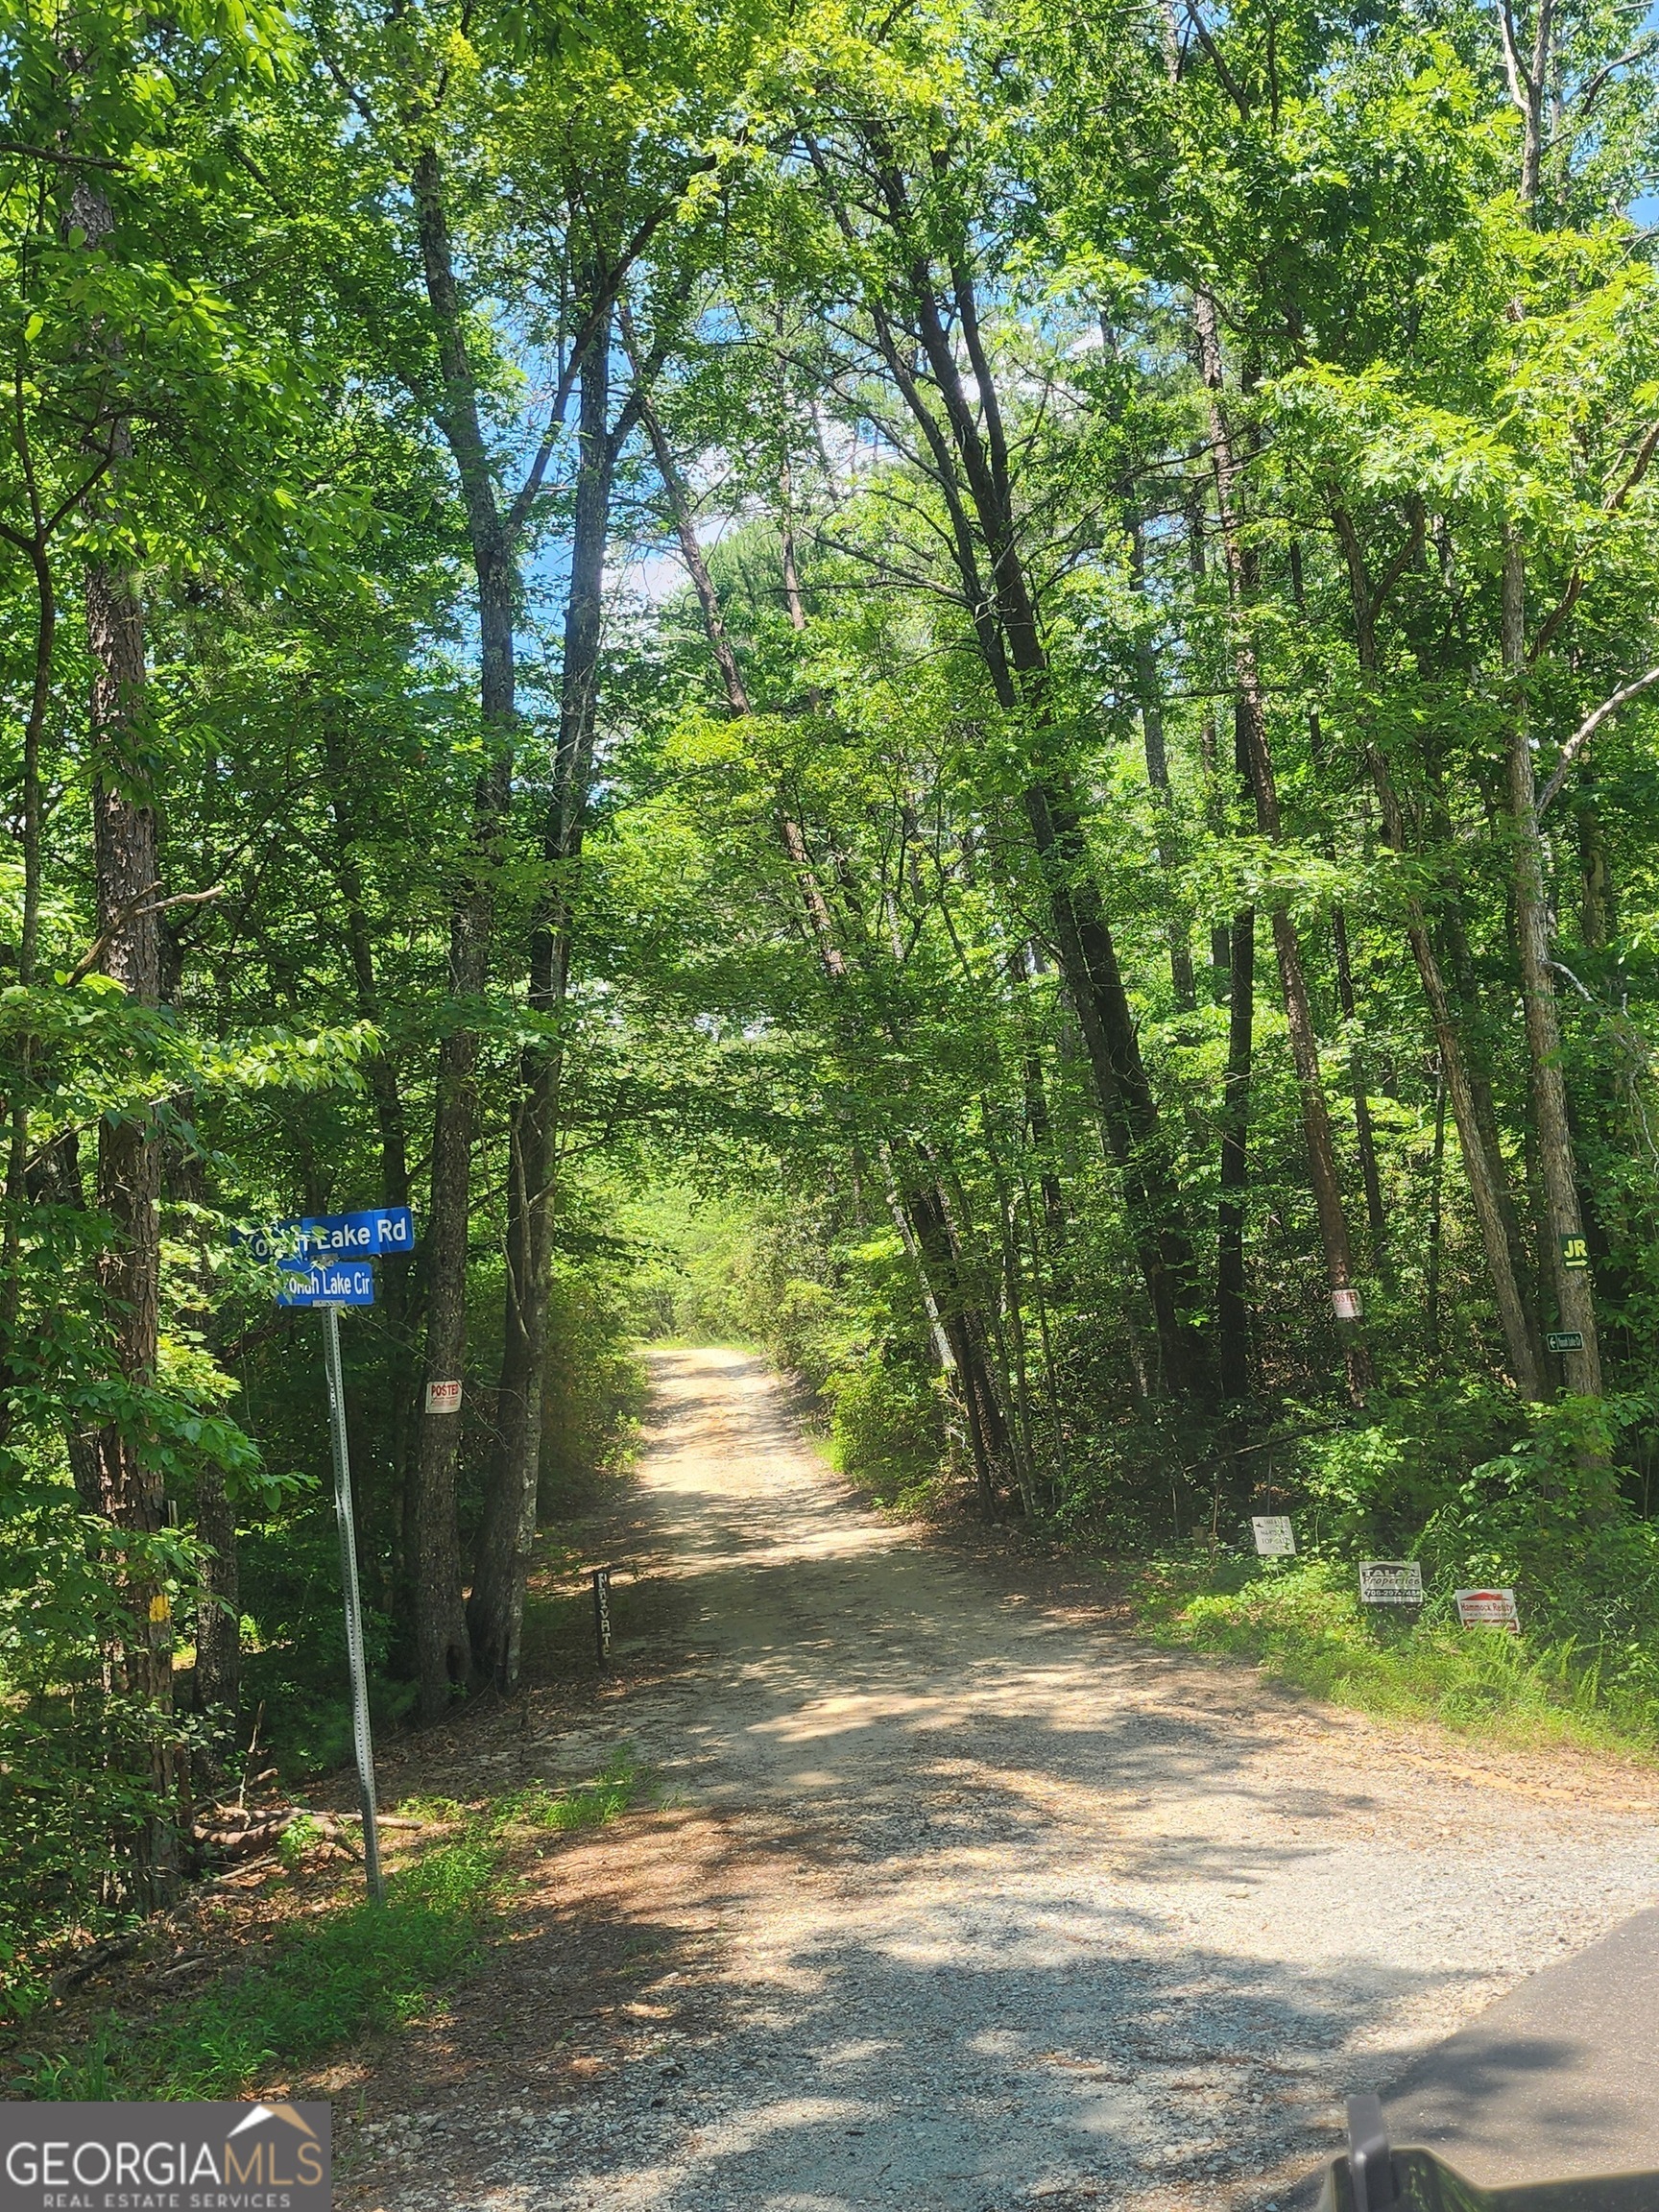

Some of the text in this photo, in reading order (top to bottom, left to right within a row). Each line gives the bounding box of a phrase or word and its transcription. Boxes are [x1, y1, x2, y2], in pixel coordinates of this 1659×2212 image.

[317, 1223, 371, 1250] Lake
[377, 1217, 406, 1242] Rd
[1564, 1239, 1587, 1258] JR
[285, 1271, 370, 1294] onah Lake Cir
